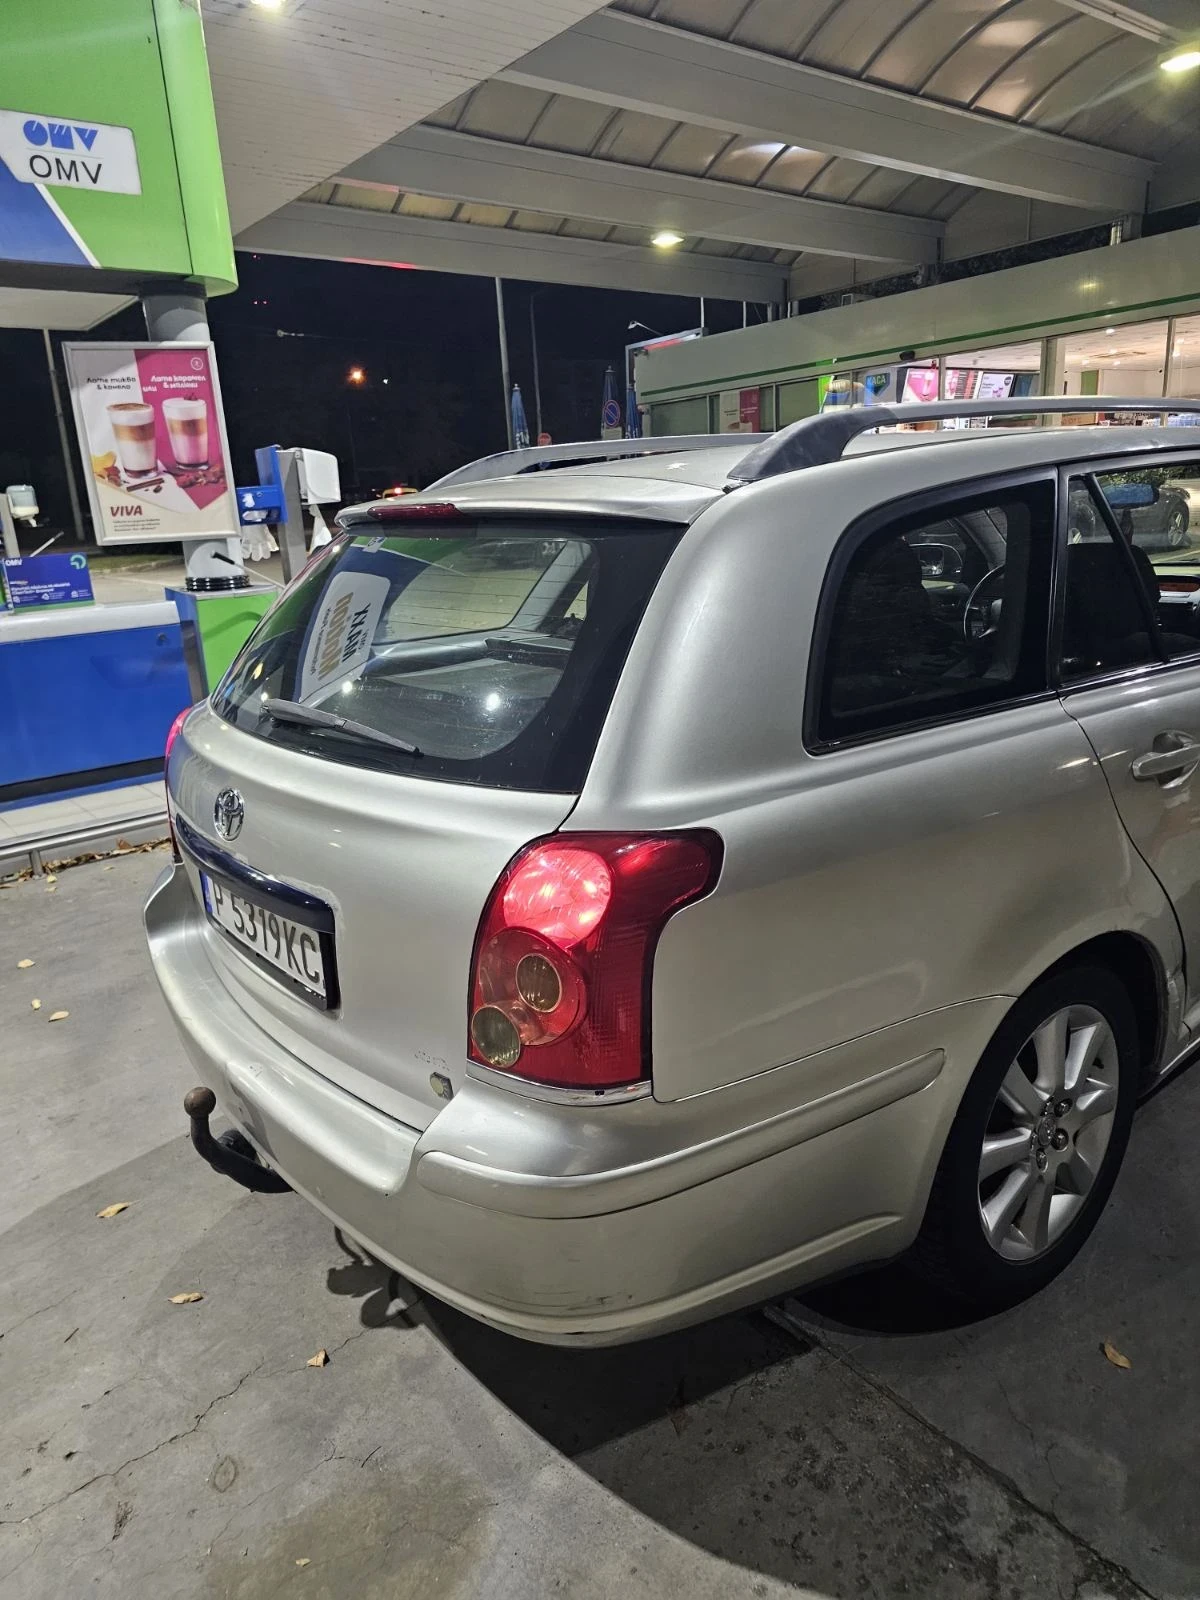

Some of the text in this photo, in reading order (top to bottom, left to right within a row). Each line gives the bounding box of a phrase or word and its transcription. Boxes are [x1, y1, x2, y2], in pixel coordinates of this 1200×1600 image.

[22, 119, 99, 152] OMV
[29, 154, 102, 184] OMV
[110, 505, 143, 517] VIVA
[5, 558, 23, 567] OMV
